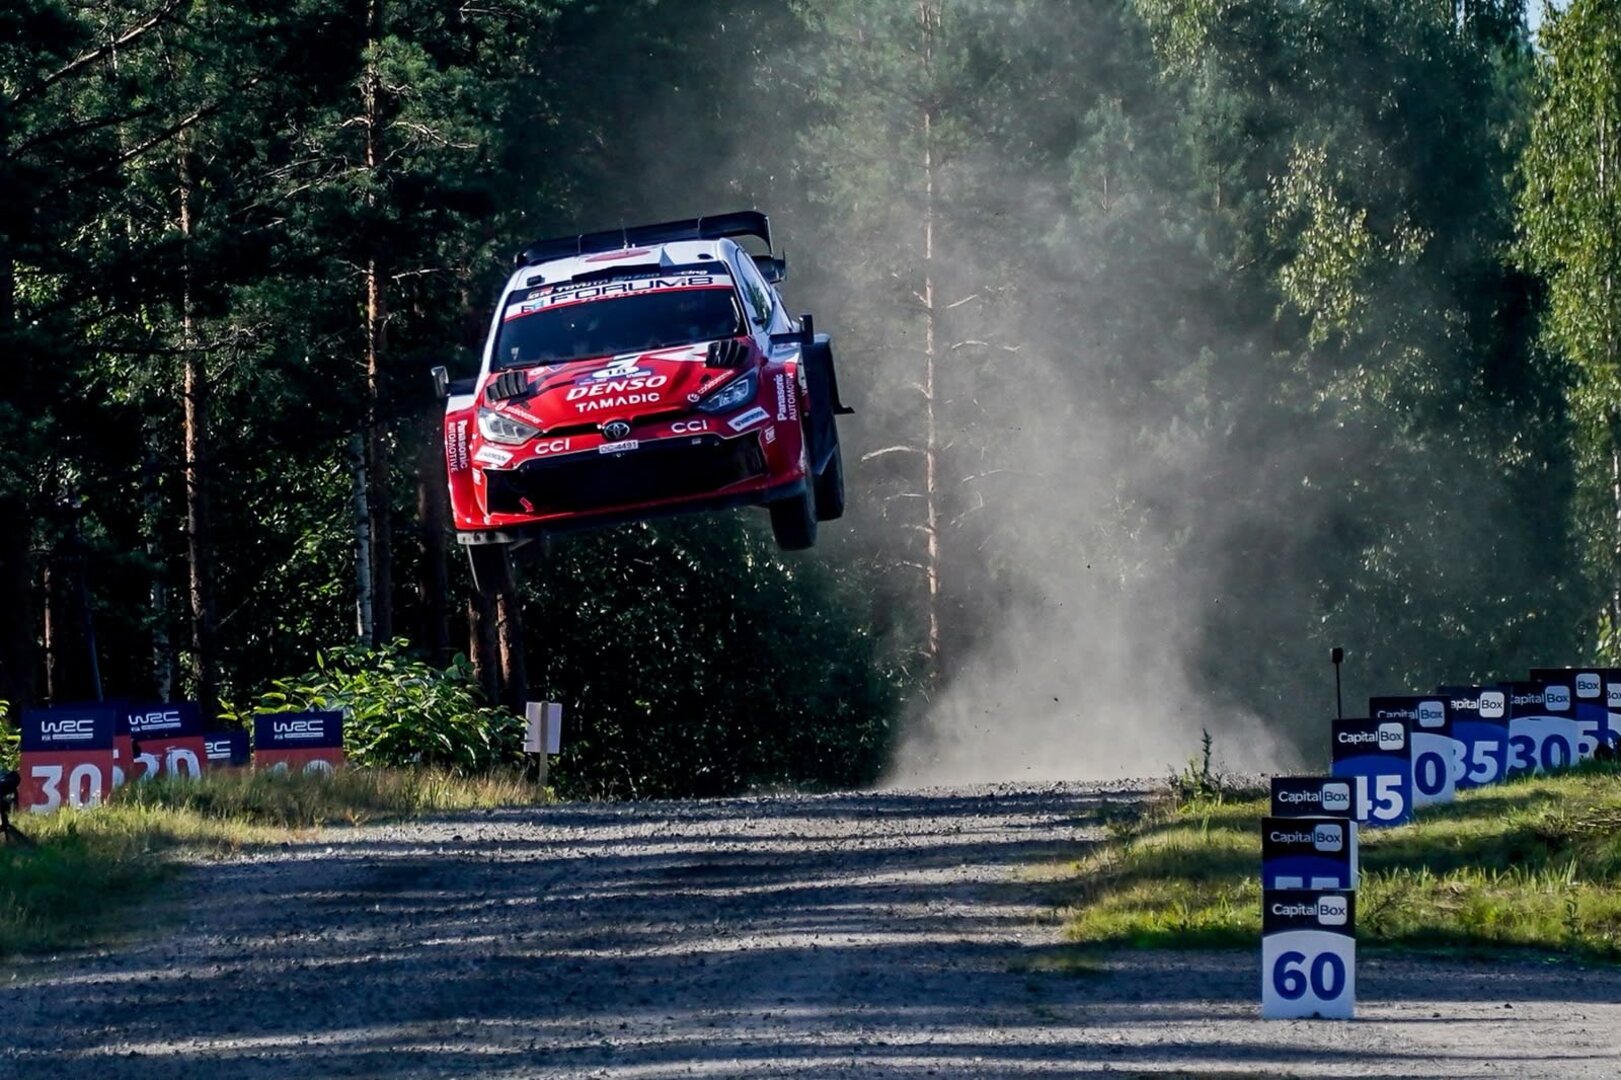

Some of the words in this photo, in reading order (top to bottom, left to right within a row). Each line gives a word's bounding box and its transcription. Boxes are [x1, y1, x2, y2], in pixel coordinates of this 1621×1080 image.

[550, 276, 714, 304] FORUM8
[566, 375, 668, 401] DENSO
[575, 392, 660, 413] TAMADIC
[774, 373, 788, 421] Panasonic
[671, 419, 709, 434] CCI
[534, 439, 571, 455] CCI
[1577, 681, 1599, 689] Box
[1450, 698, 1480, 711] apital
[1482, 700, 1503, 709] Box
[1510, 692, 1545, 706] apital
[1547, 693, 1569, 703] Box
[127, 711, 181, 725] WRC
[1420, 710, 1443, 720] Box
[41, 719, 94, 733] WRC
[273, 719, 324, 733] WRC
[1338, 731, 1379, 745] Capital
[1380, 732, 1403, 742] Box
[1507, 733, 1571, 774] 30
[31, 763, 102, 813] 30
[1278, 790, 1322, 804] Capital
[1324, 791, 1348, 802] Box
[1270, 830, 1314, 845] Capital
[1316, 832, 1341, 843] Box
[1272, 903, 1317, 918] Capital
[1320, 905, 1346, 917] Box
[1272, 951, 1346, 1001] 60
